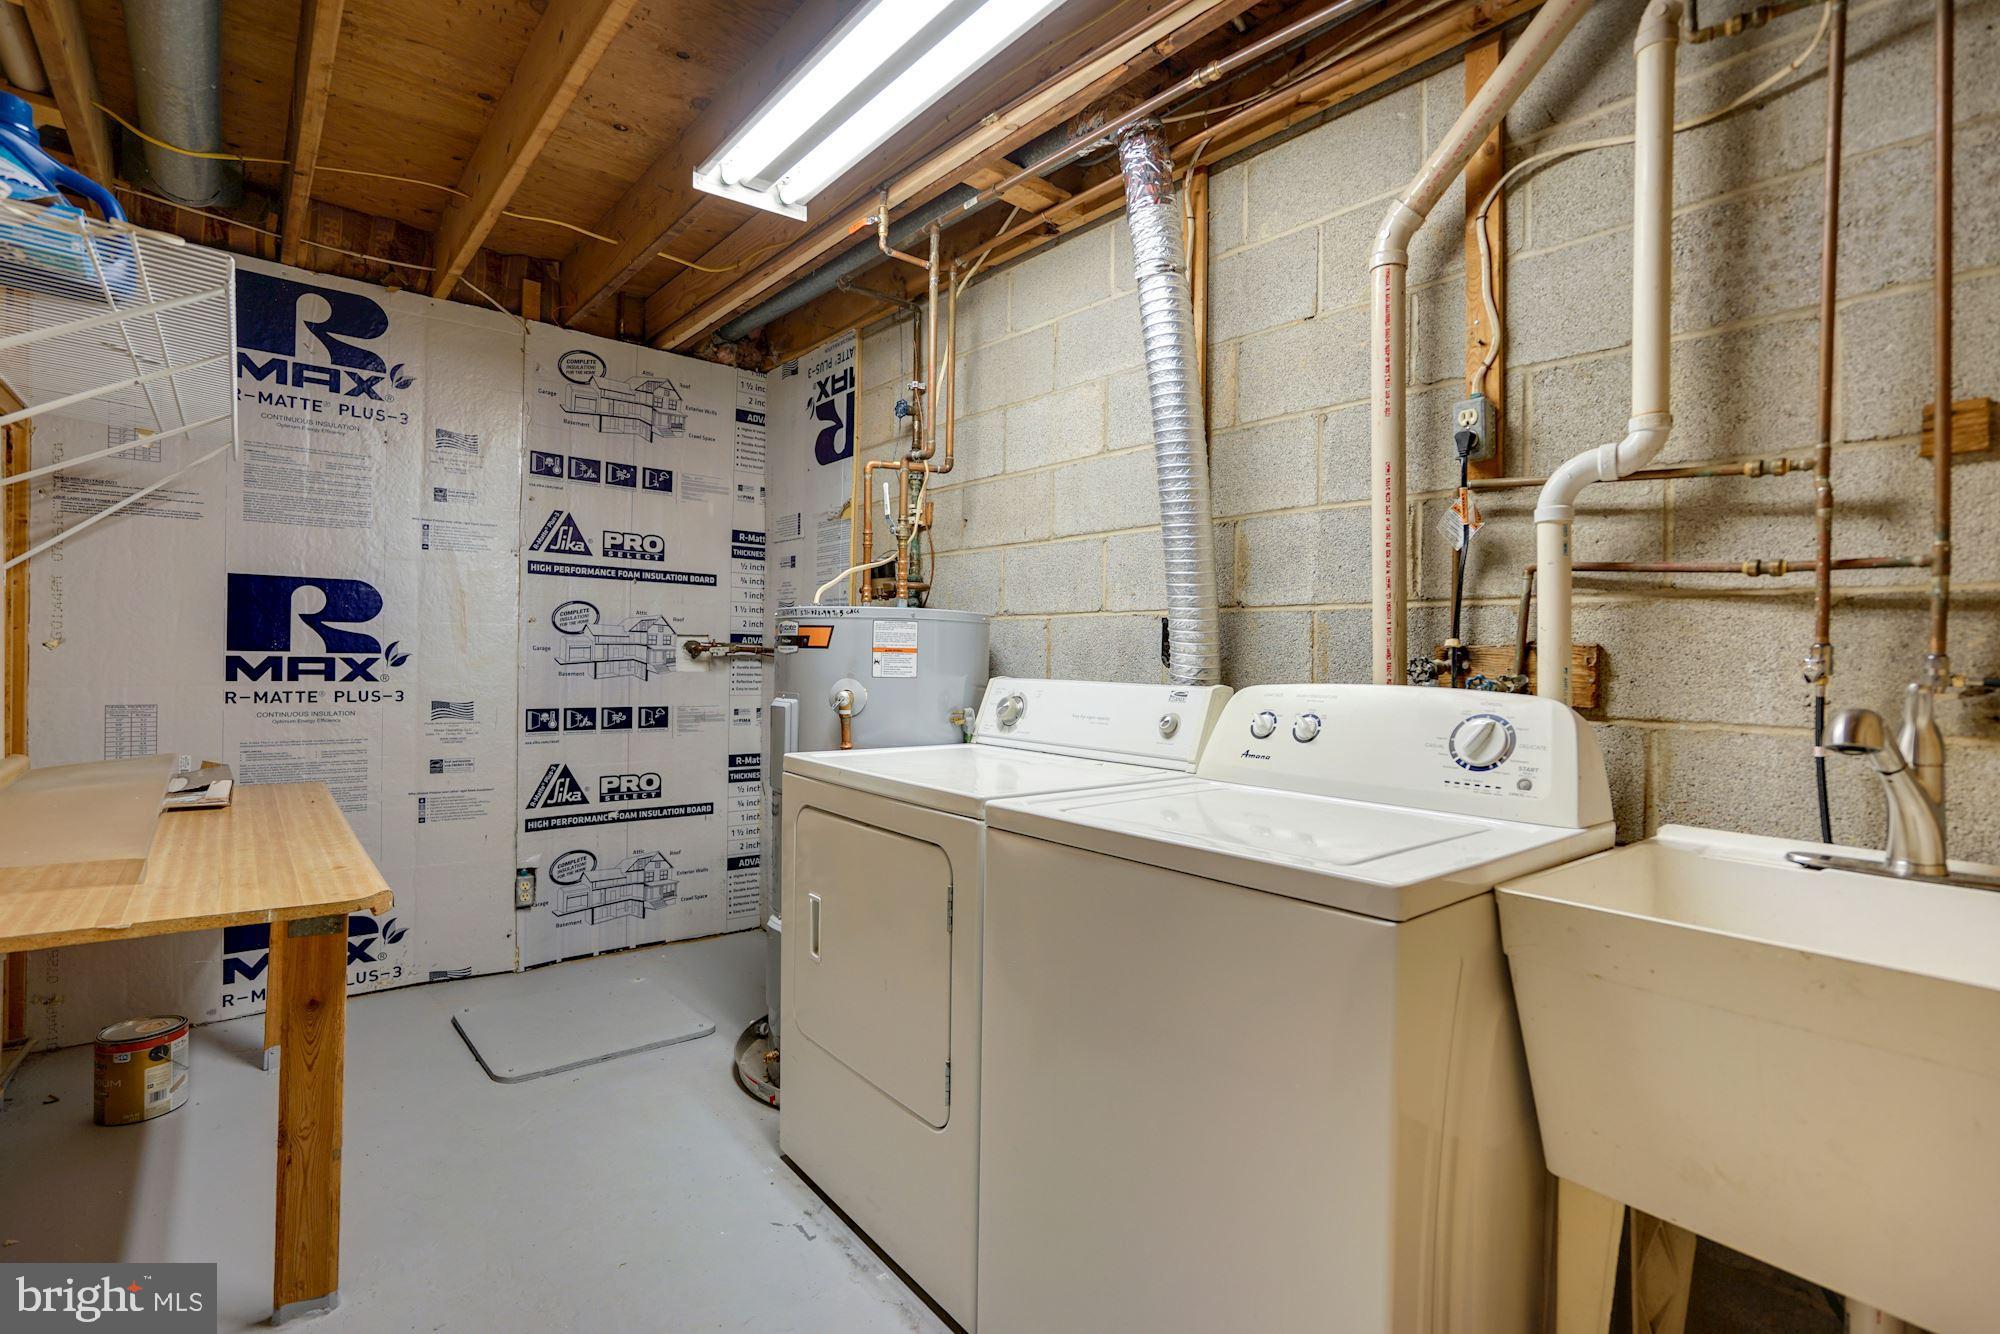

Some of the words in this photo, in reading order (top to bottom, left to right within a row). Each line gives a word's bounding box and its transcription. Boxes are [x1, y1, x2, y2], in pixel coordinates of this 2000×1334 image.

[807, 357, 833, 379] PLUS-3
[538, 388, 557, 397] Garage
[339, 404, 409, 425] PLUS-3
[260, 412, 314, 426] CONTINUOUS
[315, 421, 361, 432] INSULATION
[563, 418, 590, 428] Basement
[550, 526, 585, 551] Sika
[603, 531, 664, 553] PRO
[608, 551, 660, 561] SELECT
[530, 563, 552, 572] HIGH
[553, 565, 616, 577] PERFORMANCE
[617, 569, 641, 579] FOAM
[642, 571, 689, 582] INSULATION
[690, 574, 715, 584] BOARD
[227, 572, 383, 654] R
[560, 608, 590, 616] COMPLETE
[748, 620, 764, 628] inch
[532, 645, 551, 653] Garage
[334, 690, 405, 704] PLUS-3
[1240, 749, 1271, 760] Amana
[600, 773, 661, 793] PRO
[547, 778, 581, 804] Sika
[604, 792, 657, 801] SELECT
[527, 820, 550, 830] HIGH
[638, 808, 685, 819] INSULATION
[686, 804, 712, 814] BOARD
[557, 856, 587, 869] COMPLETE
[555, 919, 582, 929] Basement
